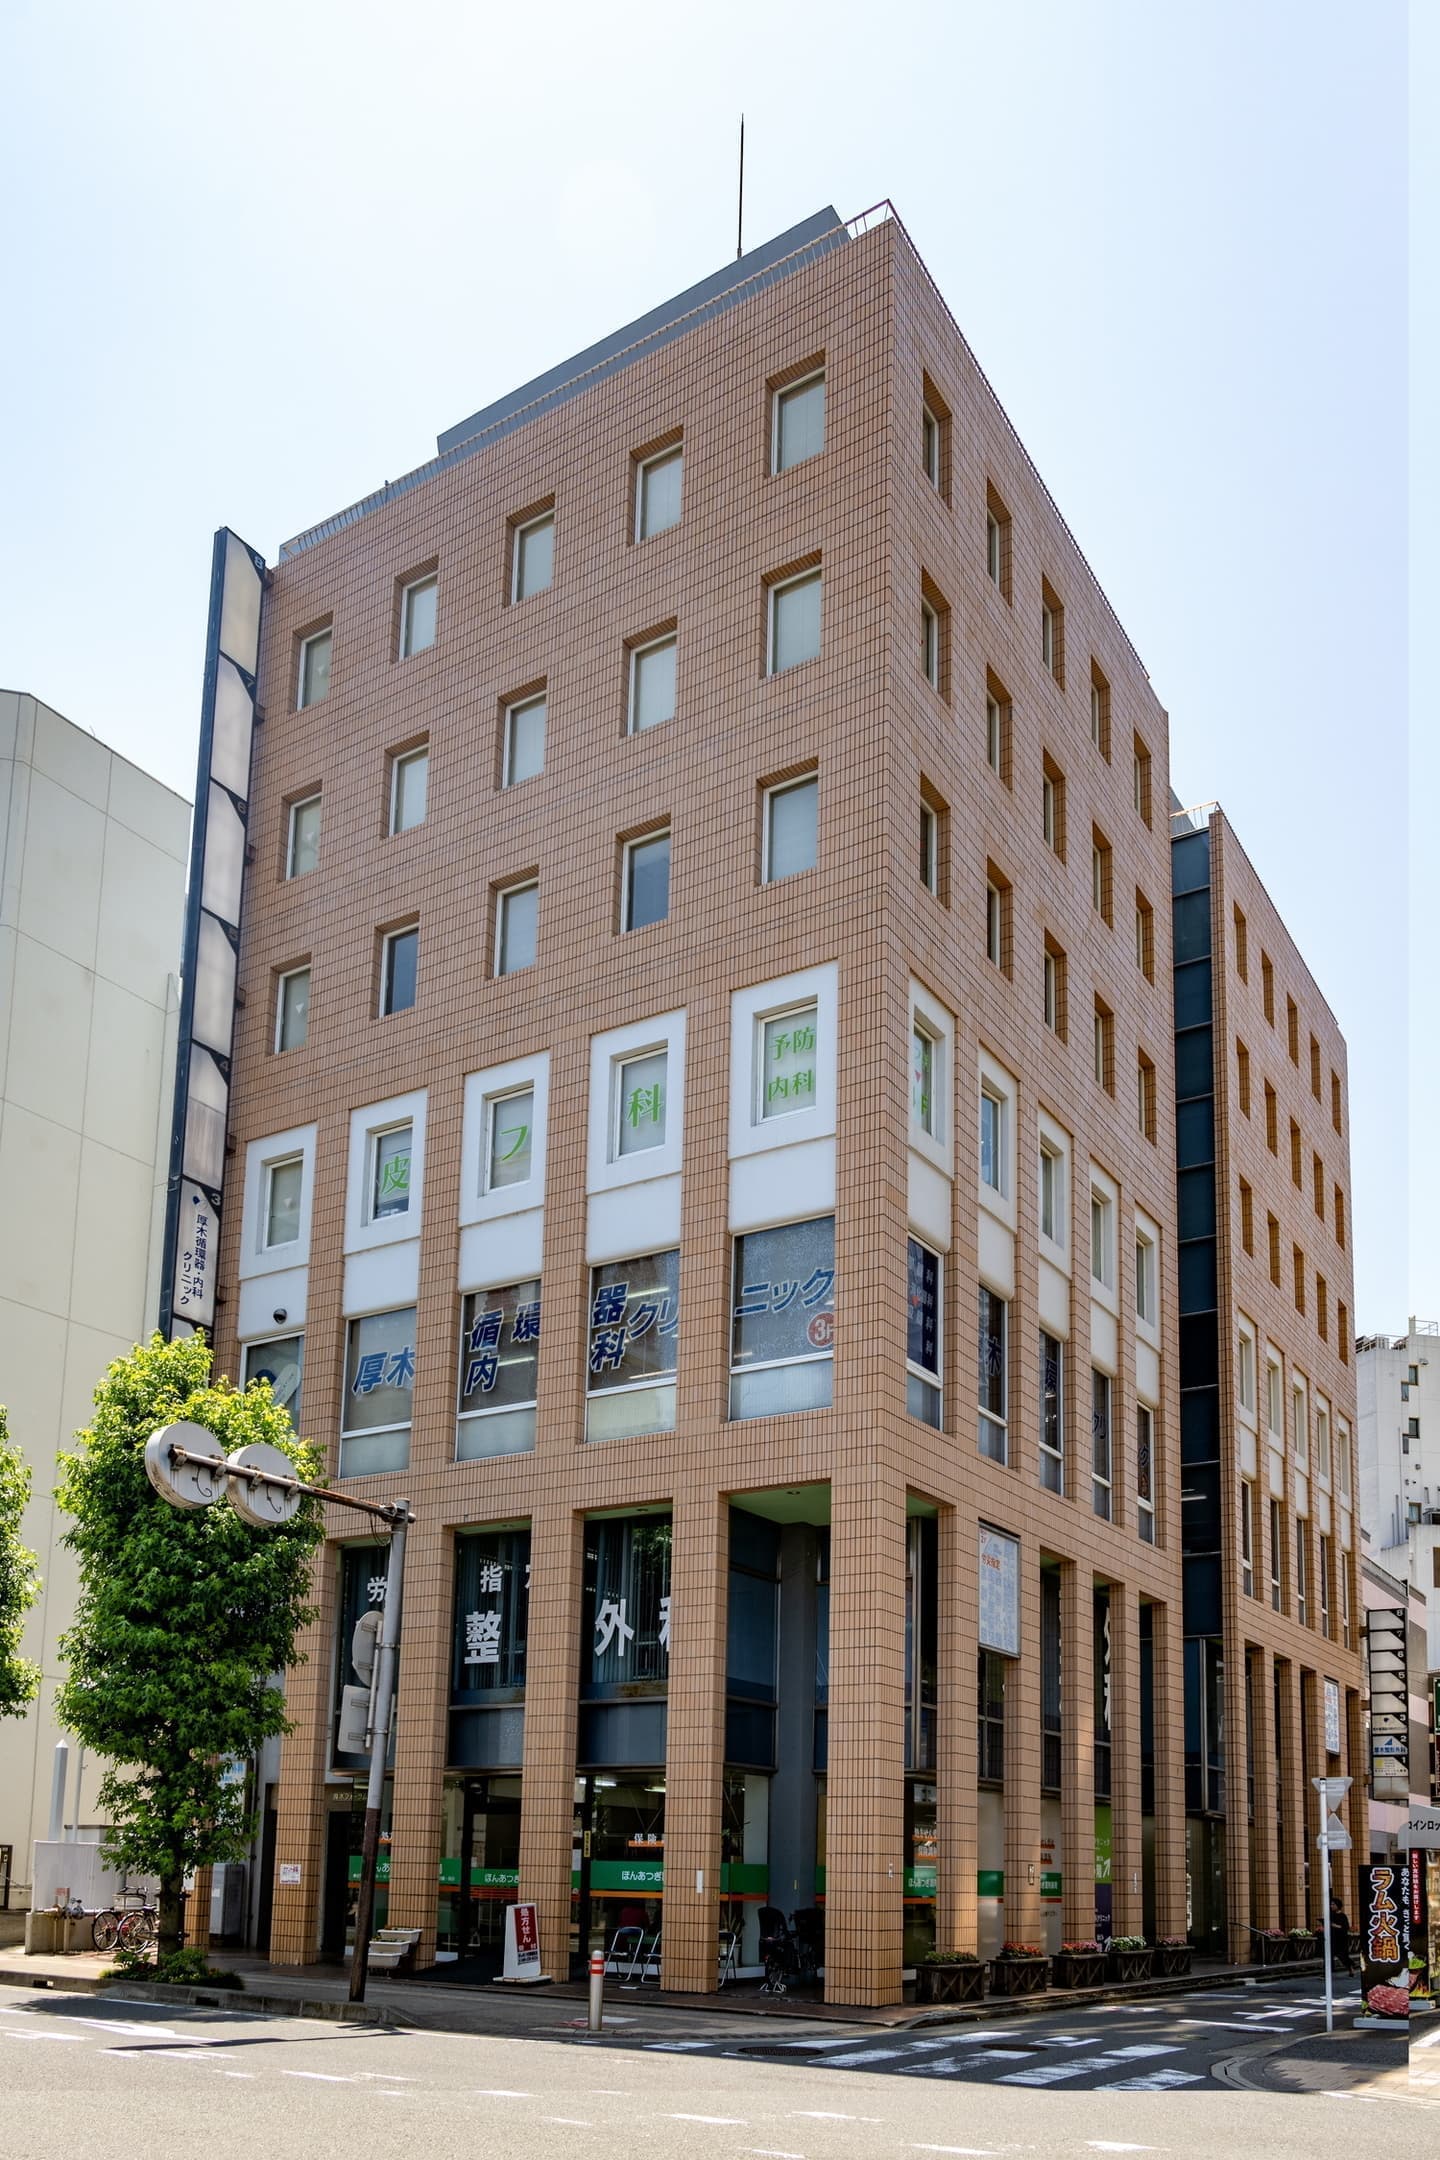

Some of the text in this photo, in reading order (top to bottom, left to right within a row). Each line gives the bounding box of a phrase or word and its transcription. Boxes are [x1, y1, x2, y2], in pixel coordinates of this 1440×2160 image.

[769, 1026, 816, 1061] 予防
[768, 1069, 813, 1101] 内科
[381, 1084, 662, 1194] 皮 フ 科
[211, 1192, 222, 1206] 3
[180, 1251, 192, 1306] クリニック
[351, 1344, 415, 1394] 厚木
[733, 1266, 835, 1317] ニック
[464, 1327, 626, 1397] 内 科
[464, 1610, 502, 1665] 整
[621, 1870, 664, 1881] ほんあつぎ
[520, 1907, 532, 1944] 処方せん
[1368, 1866, 1400, 1963] ラム火鍋
